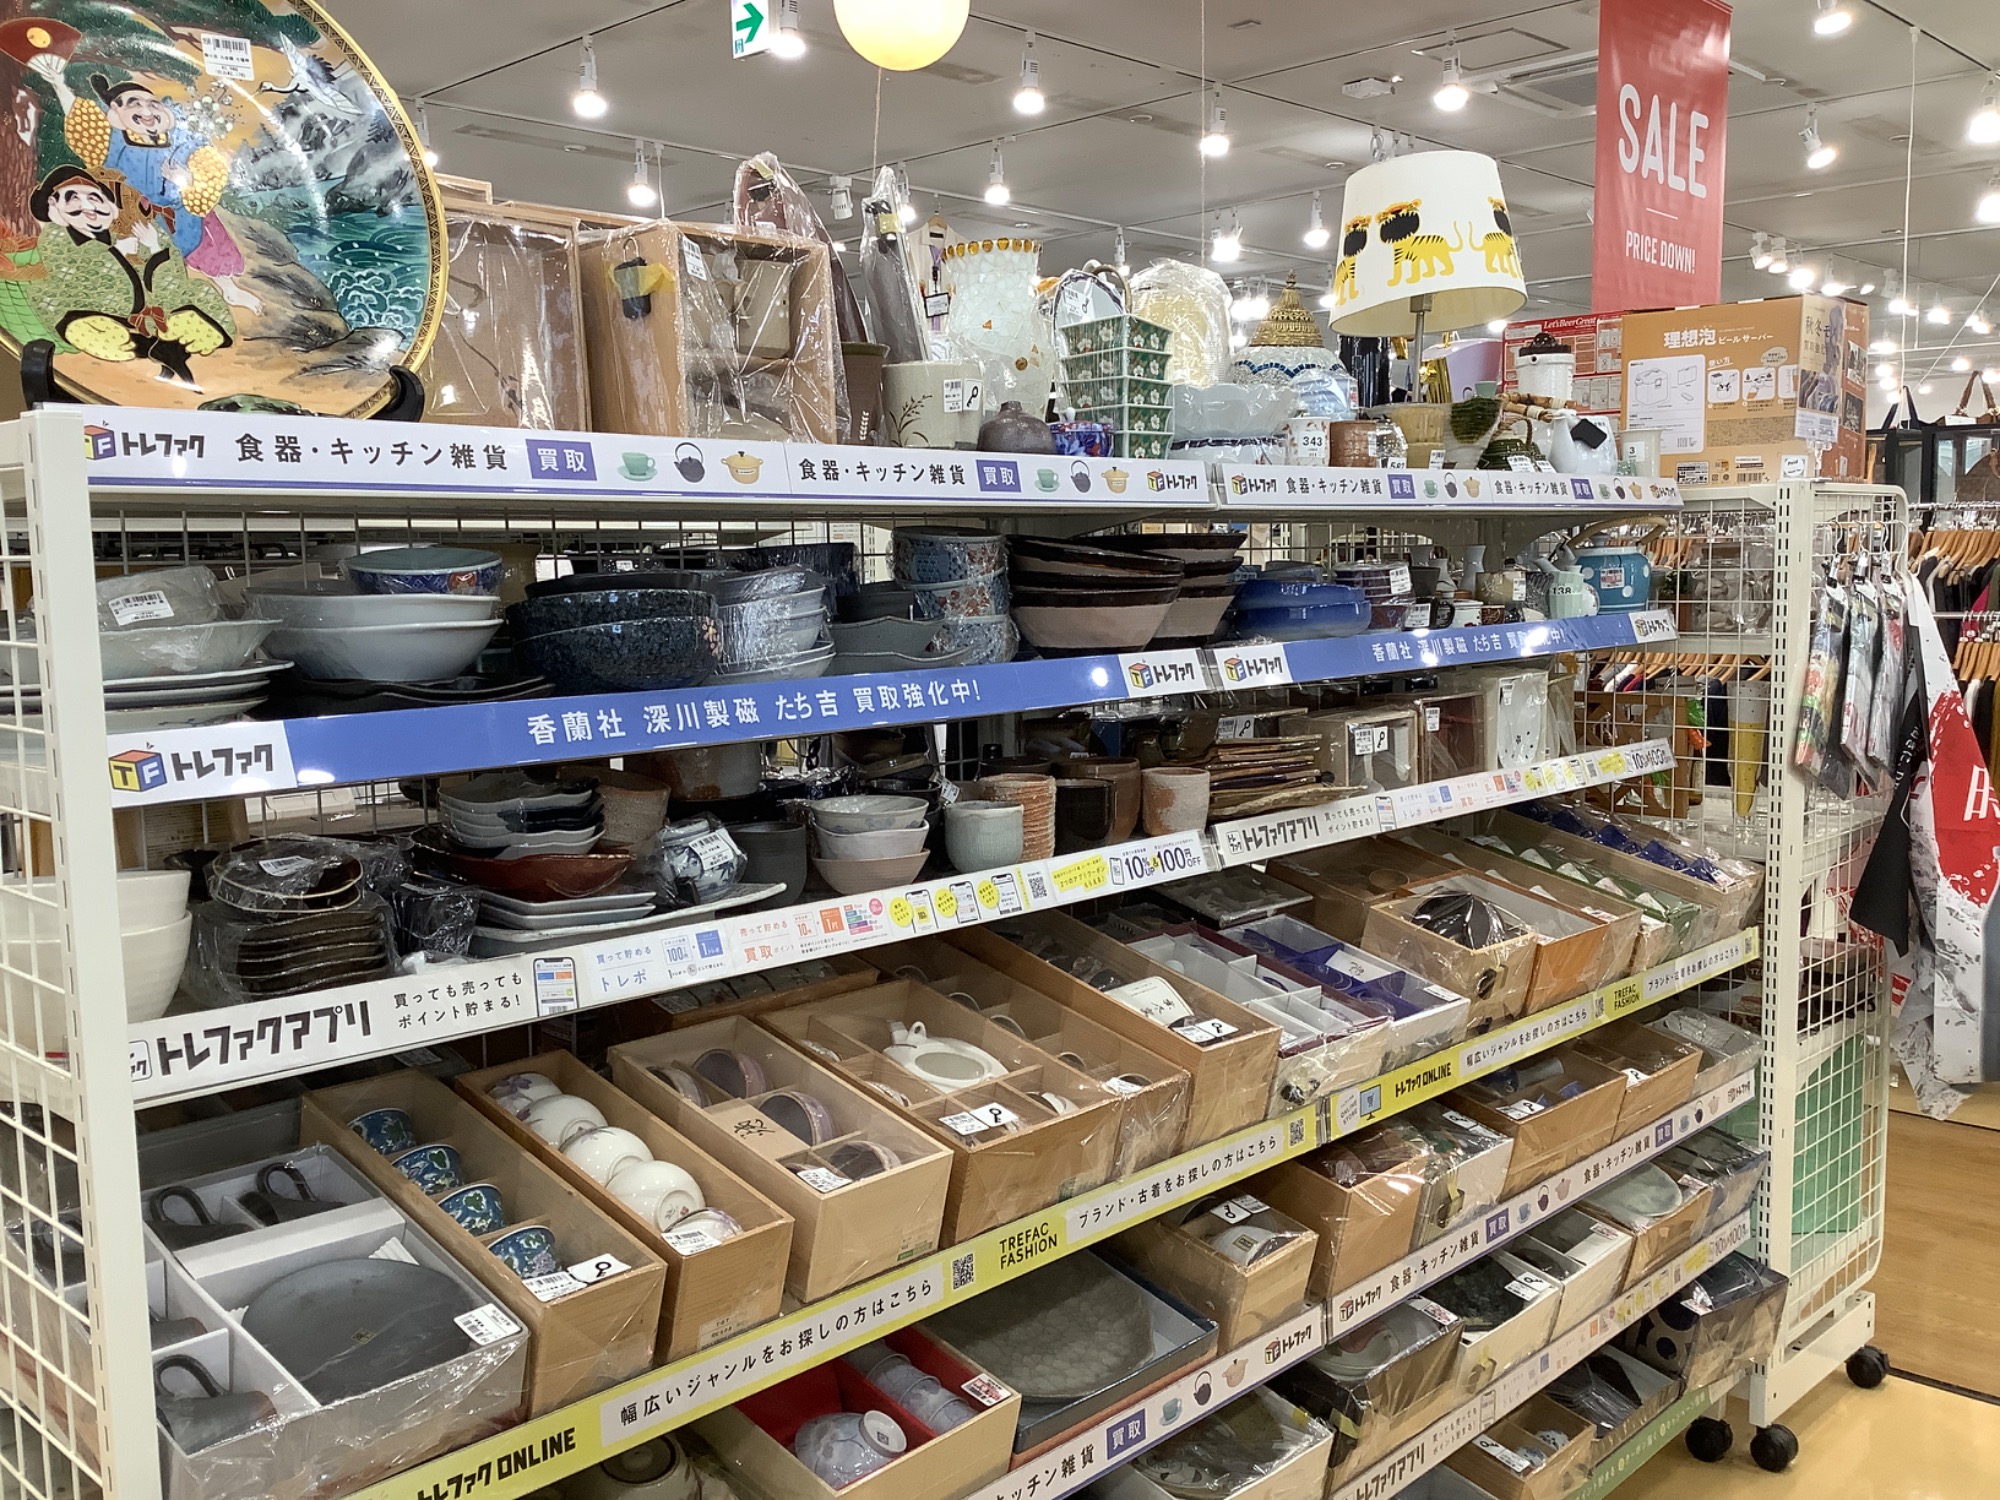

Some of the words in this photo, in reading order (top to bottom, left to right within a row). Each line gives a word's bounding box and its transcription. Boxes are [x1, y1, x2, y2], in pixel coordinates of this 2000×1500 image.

[1619, 83, 1709, 199] SALE
[1626, 230, 1657, 264] PRICE
[1660, 241, 1696, 275] DOWN!
[1664, 328, 1716, 349] 理想泡
[121, 432, 205, 458] トレファク
[235, 433, 508, 470] 食器・キッチン雑貨
[537, 448, 588, 472] 買取
[1303, 436, 1323, 447] 343
[799, 458, 966, 486] 食器・キッチン雑貨
[983, 466, 1016, 486] 買取
[1286, 477, 1382, 494] 食器・キッチン雑貨
[1391, 479, 1412, 495] 買取
[1494, 480, 1568, 496] 食器・キッチン雑貨
[1248, 657, 1283, 677] トレファク
[1372, 641, 1413, 662] 香蘭社
[1473, 632, 1502, 651] たち吉
[1153, 663, 1195, 683] トレファク
[170, 744, 273, 781] トレファク
[527, 709, 626, 745] 香蘭社
[643, 697, 760, 734] 深川製磁
[775, 690, 839, 720] たち吉
[853, 678, 981, 713] 買取強化中!
[1242, 815, 1320, 852] トレファクアプリ
[739, 920, 788, 937] 売って貯める
[596, 946, 652, 964] 買って貯める
[393, 973, 523, 1009] 買っても売っても
[602, 969, 647, 992] トレポ
[1614, 984, 1636, 1000] TREFAC
[398, 994, 521, 1029] ポイント貯まる!
[1614, 993, 1640, 1011] FASHION
[157, 1000, 371, 1076] トレファクアプリ
[1466, 1009, 1587, 1067] 幅広いジャンルをお探しの方はこちら
[1422, 1062, 1452, 1087] ONLINE
[1079, 1135, 1278, 1229] ブランド・古着をお探しの方はこちら
[999, 1222, 1050, 1254] TREFAC
[1000, 1233, 1058, 1269] FASHION
[1390, 1229, 1479, 1294] 食器・キッチン雑貨
[620, 1279, 933, 1426] 幅広いジャンルをお探しの方はこちら
[497, 1427, 576, 1480] ONLINE
[995, 1444, 1095, 1500] ッチン雑貨
[1112, 1420, 1141, 1451] 買取
